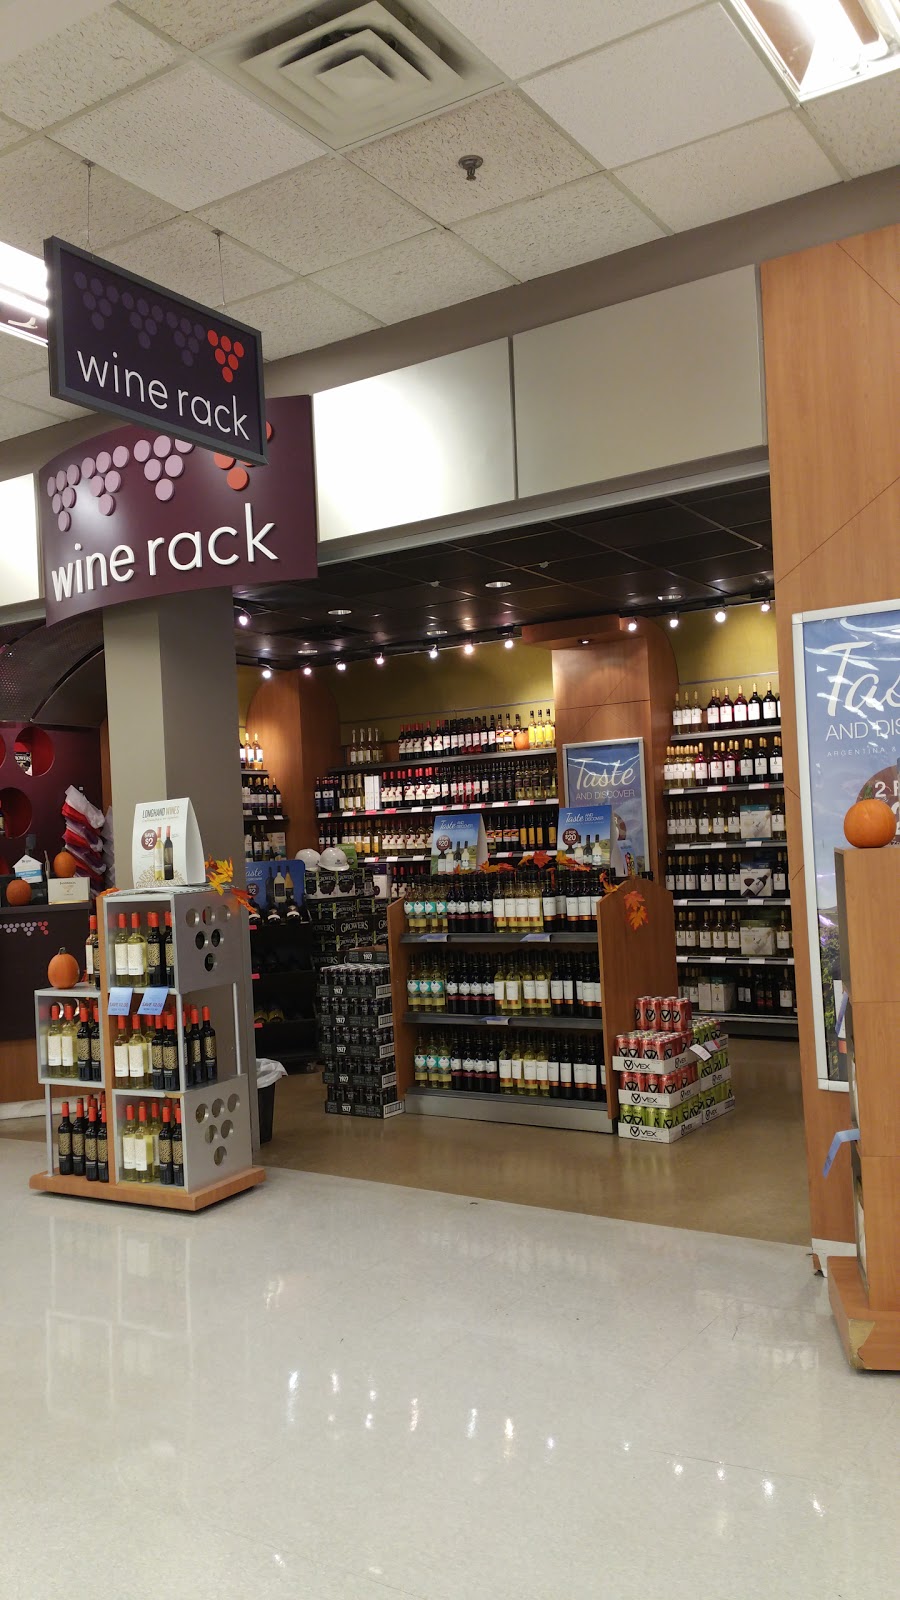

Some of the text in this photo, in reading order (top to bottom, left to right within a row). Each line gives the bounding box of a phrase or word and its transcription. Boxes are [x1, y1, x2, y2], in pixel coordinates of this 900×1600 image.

[76, 350, 250, 441] wine rack
[51, 502, 279, 602] wine rack
[825, 722, 869, 741] AND
[827, 747, 885, 757] ARGENTINA
[576, 757, 637, 790] Taste
[575, 788, 636, 801] AND DISCOVER
[142, 807, 165, 819] LONGHAND
[565, 812, 584, 823] Taste
[144, 837, 154, 847] $2
[245, 867, 263, 877] aste
[340, 920, 369, 933] GROWERS
[634, 1062, 650, 1070] VEX
